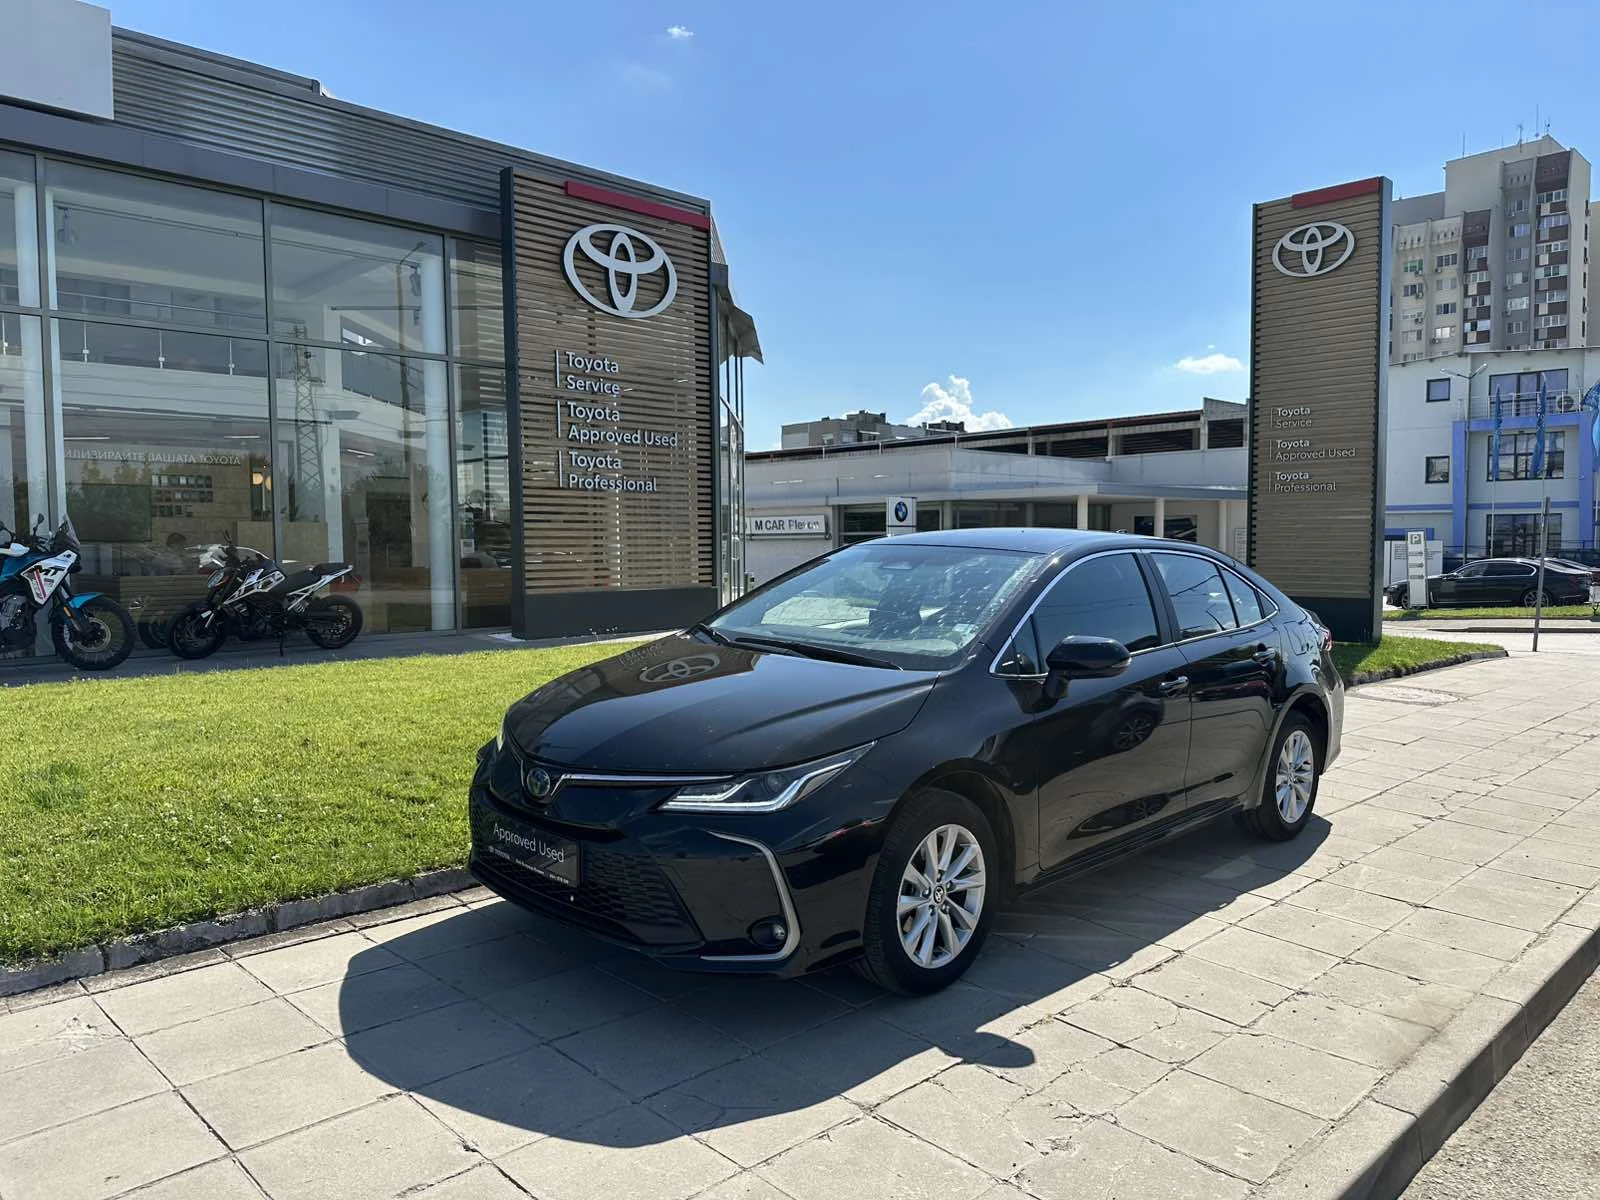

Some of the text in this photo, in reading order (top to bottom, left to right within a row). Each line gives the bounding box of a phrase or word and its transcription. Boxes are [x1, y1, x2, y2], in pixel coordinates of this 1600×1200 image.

[566, 351, 619, 374] Toyota
[566, 375, 620, 395] Service
[567, 401, 620, 423] Toyota
[1278, 408, 1310, 418] Toyota
[1275, 418, 1312, 429] Service
[568, 424, 678, 447] Approved Used
[1277, 440, 1309, 449] Toyota
[199, 453, 241, 465] TOYOTA
[568, 451, 622, 472] Toyota
[1275, 447, 1356, 462] Approved Used
[569, 474, 657, 493] Professional
[1276, 471, 1309, 481] Toyota
[1274, 481, 1337, 493] Professional
[755, 520, 763, 530] M
[765, 520, 785, 530] CAR
[493, 822, 537, 852] Approved
[539, 841, 565, 863] Used
